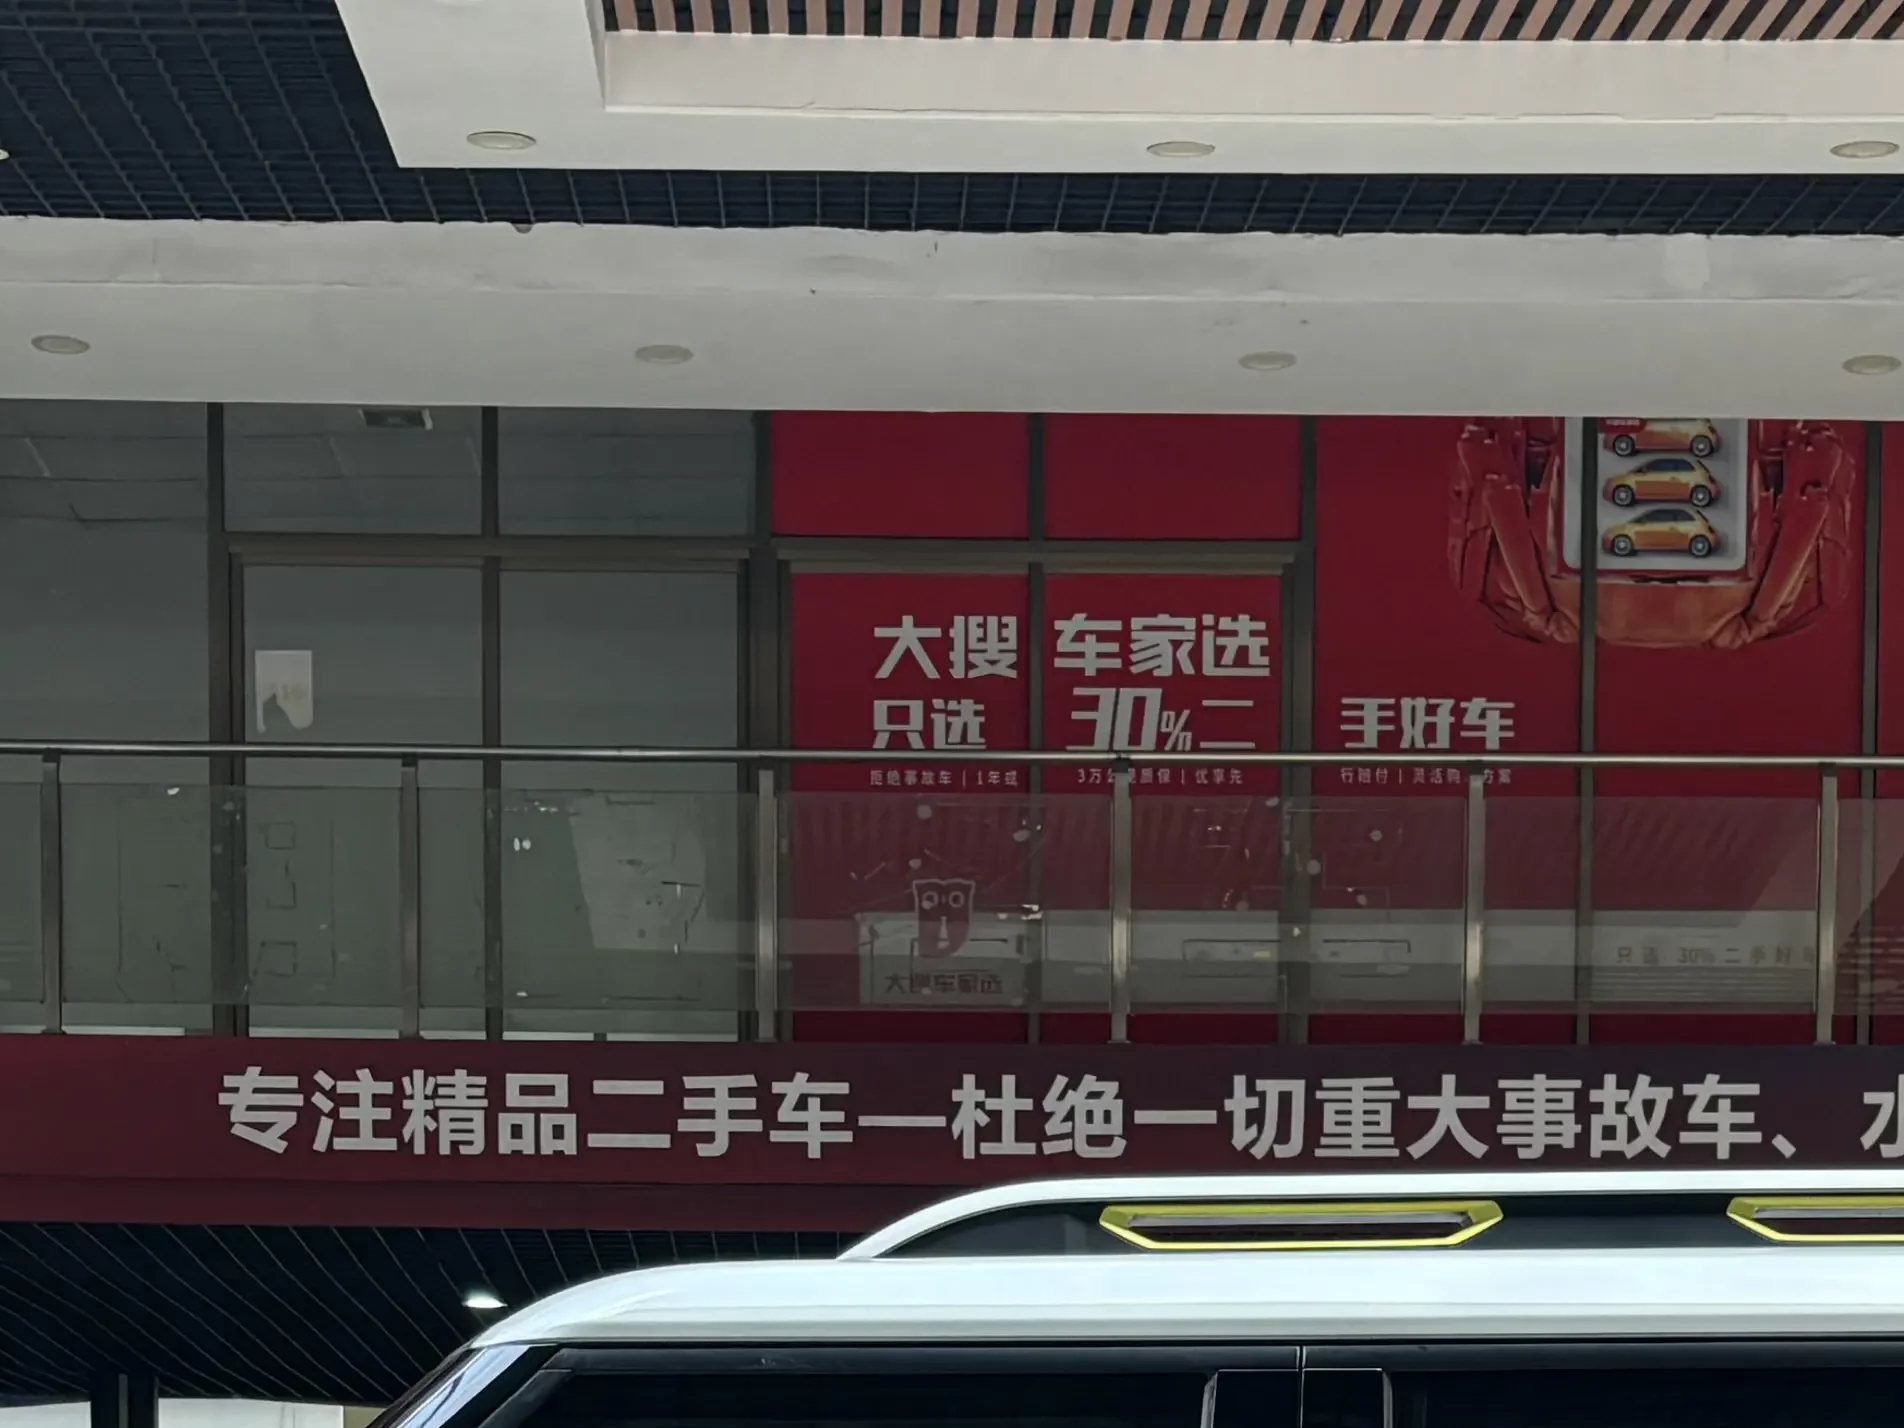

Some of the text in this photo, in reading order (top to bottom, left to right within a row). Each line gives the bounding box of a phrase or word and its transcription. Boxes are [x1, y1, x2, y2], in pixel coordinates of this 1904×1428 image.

[1412, 767, 1512, 785] 灵活购方案
